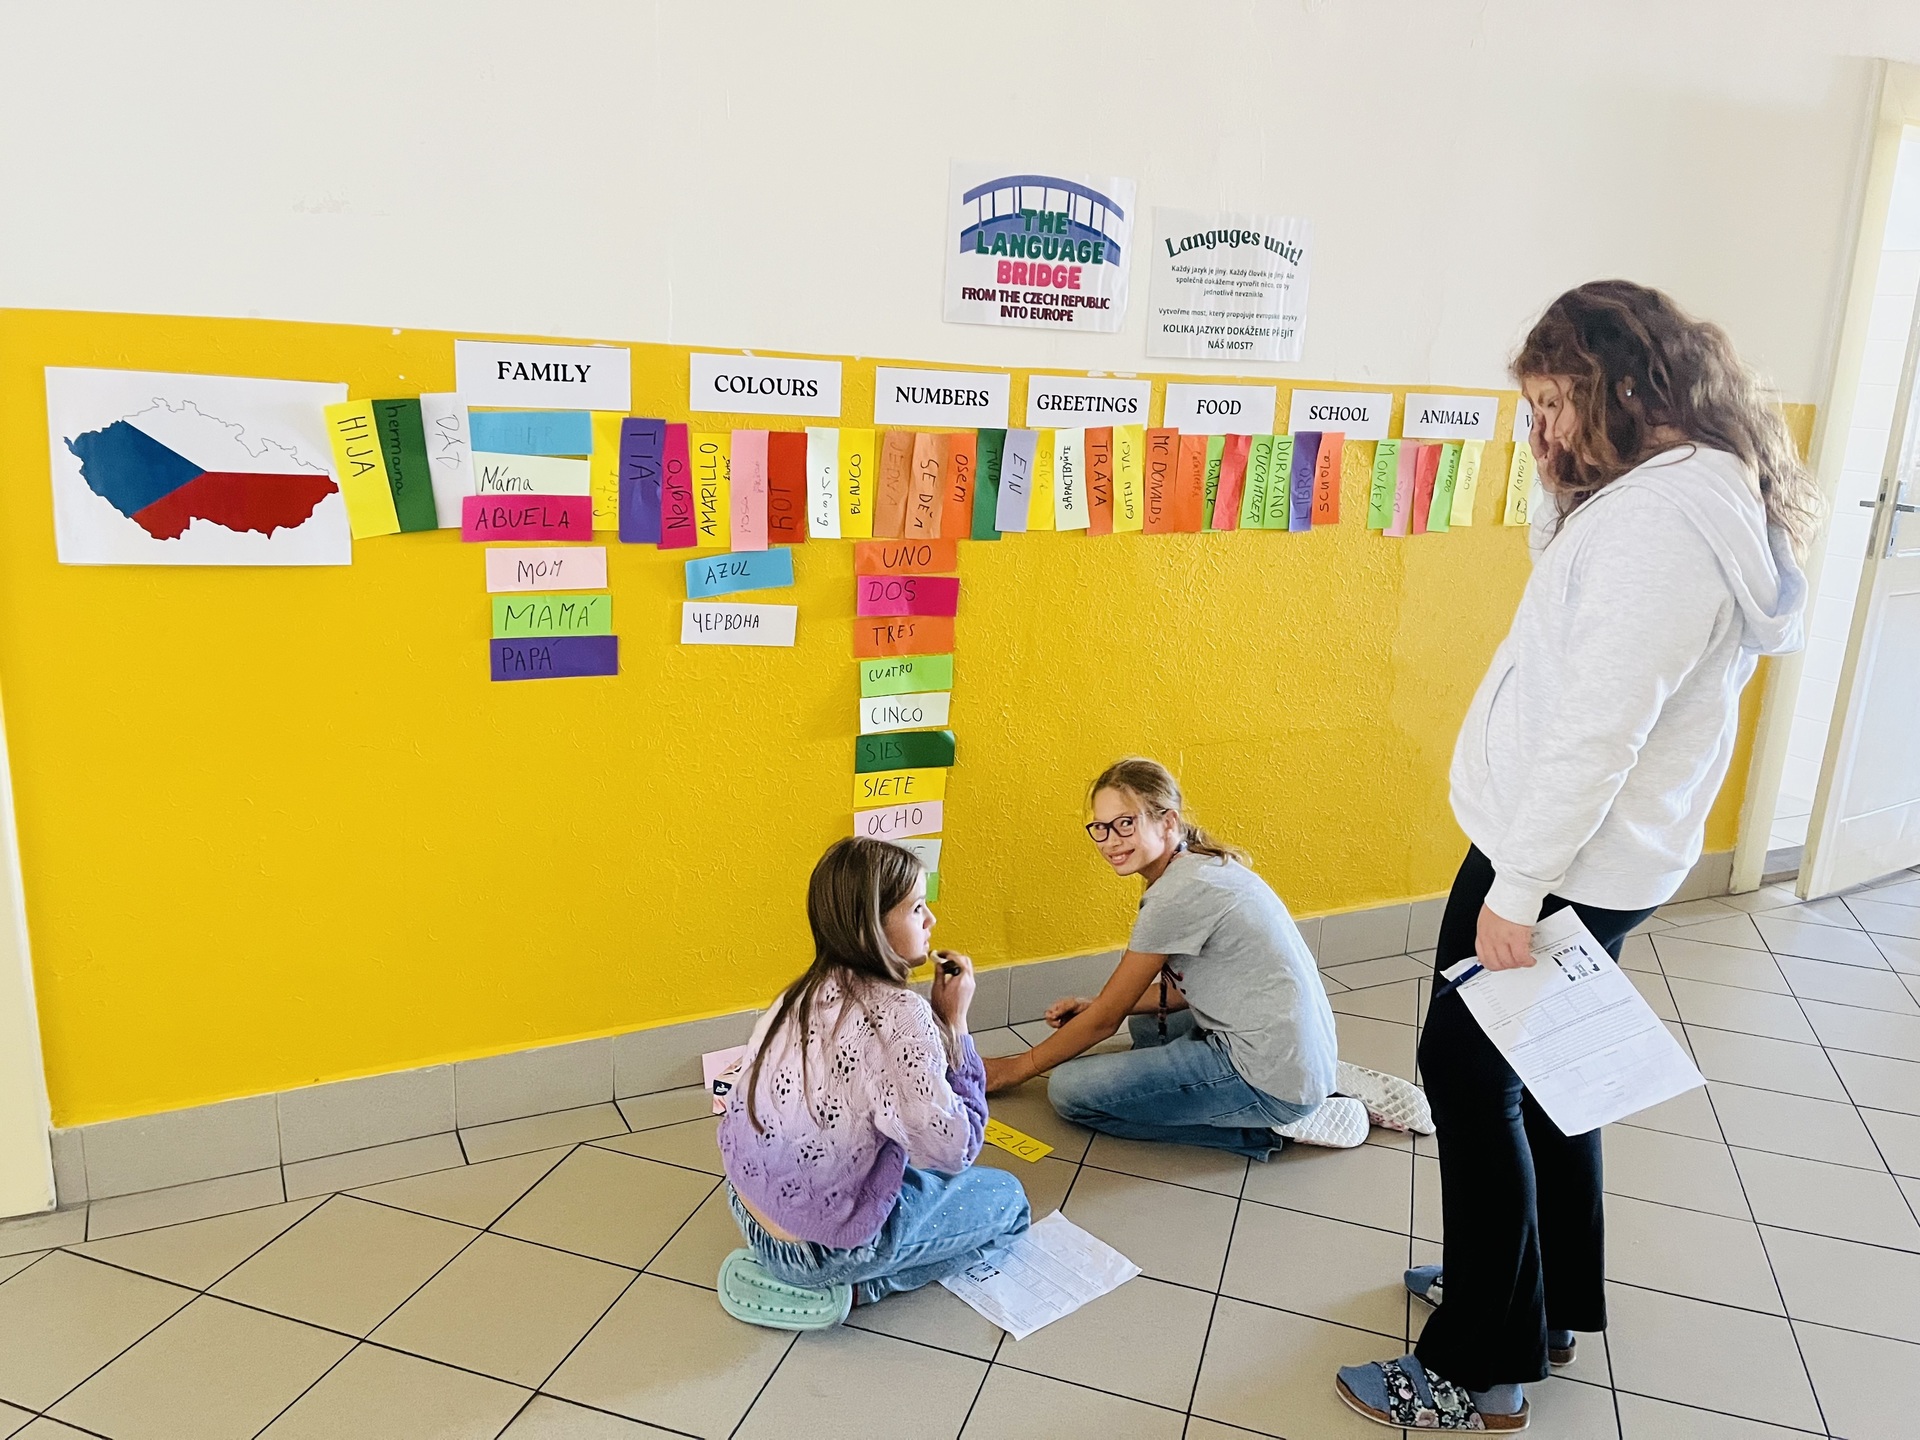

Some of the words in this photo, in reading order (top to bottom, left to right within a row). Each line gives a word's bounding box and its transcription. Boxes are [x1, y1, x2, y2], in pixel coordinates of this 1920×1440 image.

[1020, 208, 1069, 235] THE
[975, 231, 1105, 264] LANGUAGE
[1165, 229, 1261, 258] Languges
[1264, 235, 1303, 266] unit!
[997, 260, 1082, 289] BRIDGE
[1171, 265, 1191, 274] Každý
[1230, 268, 1248, 277] Každý
[962, 287, 996, 302] FROM
[999, 290, 1020, 303] THE
[1023, 292, 1059, 306] CZECH
[1061, 294, 1111, 309] REPUBLIC
[1001, 305, 1028, 319] INTO
[1030, 307, 1074, 322] EUROPE
[1163, 324, 1195, 333] KOLIKA
[1196, 325, 1225, 336] JAZYKY
[1227, 325, 1270, 337] DOKÁŽEME
[1208, 338, 1225, 349] NÁŠ
[1226, 341, 1254, 350] MOST?
[497, 361, 591, 383] FAMILY
[714, 375, 818, 397] COLOURS
[896, 386, 989, 407] NUMBERS
[1037, 394, 1138, 413] GREETINGS
[1196, 399, 1241, 415] FOOD
[1309, 405, 1369, 422] SCHOOL
[1420, 410, 1480, 425] ANIMALS
[337, 415, 375, 477] HIJA
[385, 404, 407, 496] hermana
[435, 414, 465, 469] DAD
[1152, 435, 1170, 456] MC
[481, 466, 534, 493] Máma
[850, 453, 862, 515] BLANCO
[1008, 452, 1027, 495] EIN
[1091, 440, 1111, 507] TRÁVA
[1270, 440, 1292, 519] DURAZNO
[666, 459, 691, 530] Negro
[699, 443, 719, 536] AMARILLO
[1123, 481, 1135, 520] GUTEN
[1148, 461, 1167, 525] DONALDS
[1295, 468, 1312, 520] LIBRO
[769, 478, 793, 530] ROT
[475, 507, 570, 531] ABUELA
[883, 545, 932, 568] UNO
[517, 559, 564, 585] MOM
[704, 560, 751, 585] AZUL
[868, 580, 917, 602] DOS
[504, 597, 598, 631] MAMÁ
[692, 612, 760, 633] ЧЕРВОНА
[872, 623, 915, 646] TRES
[501, 639, 561, 673] PAPÁ
[869, 663, 913, 682] CUATRO
[871, 706, 923, 725] CINCO
[866, 741, 903, 762] SIES
[864, 776, 916, 798] SIETE
[867, 807, 923, 836] OCHO
[984, 1125, 1040, 1156] PIZZ
